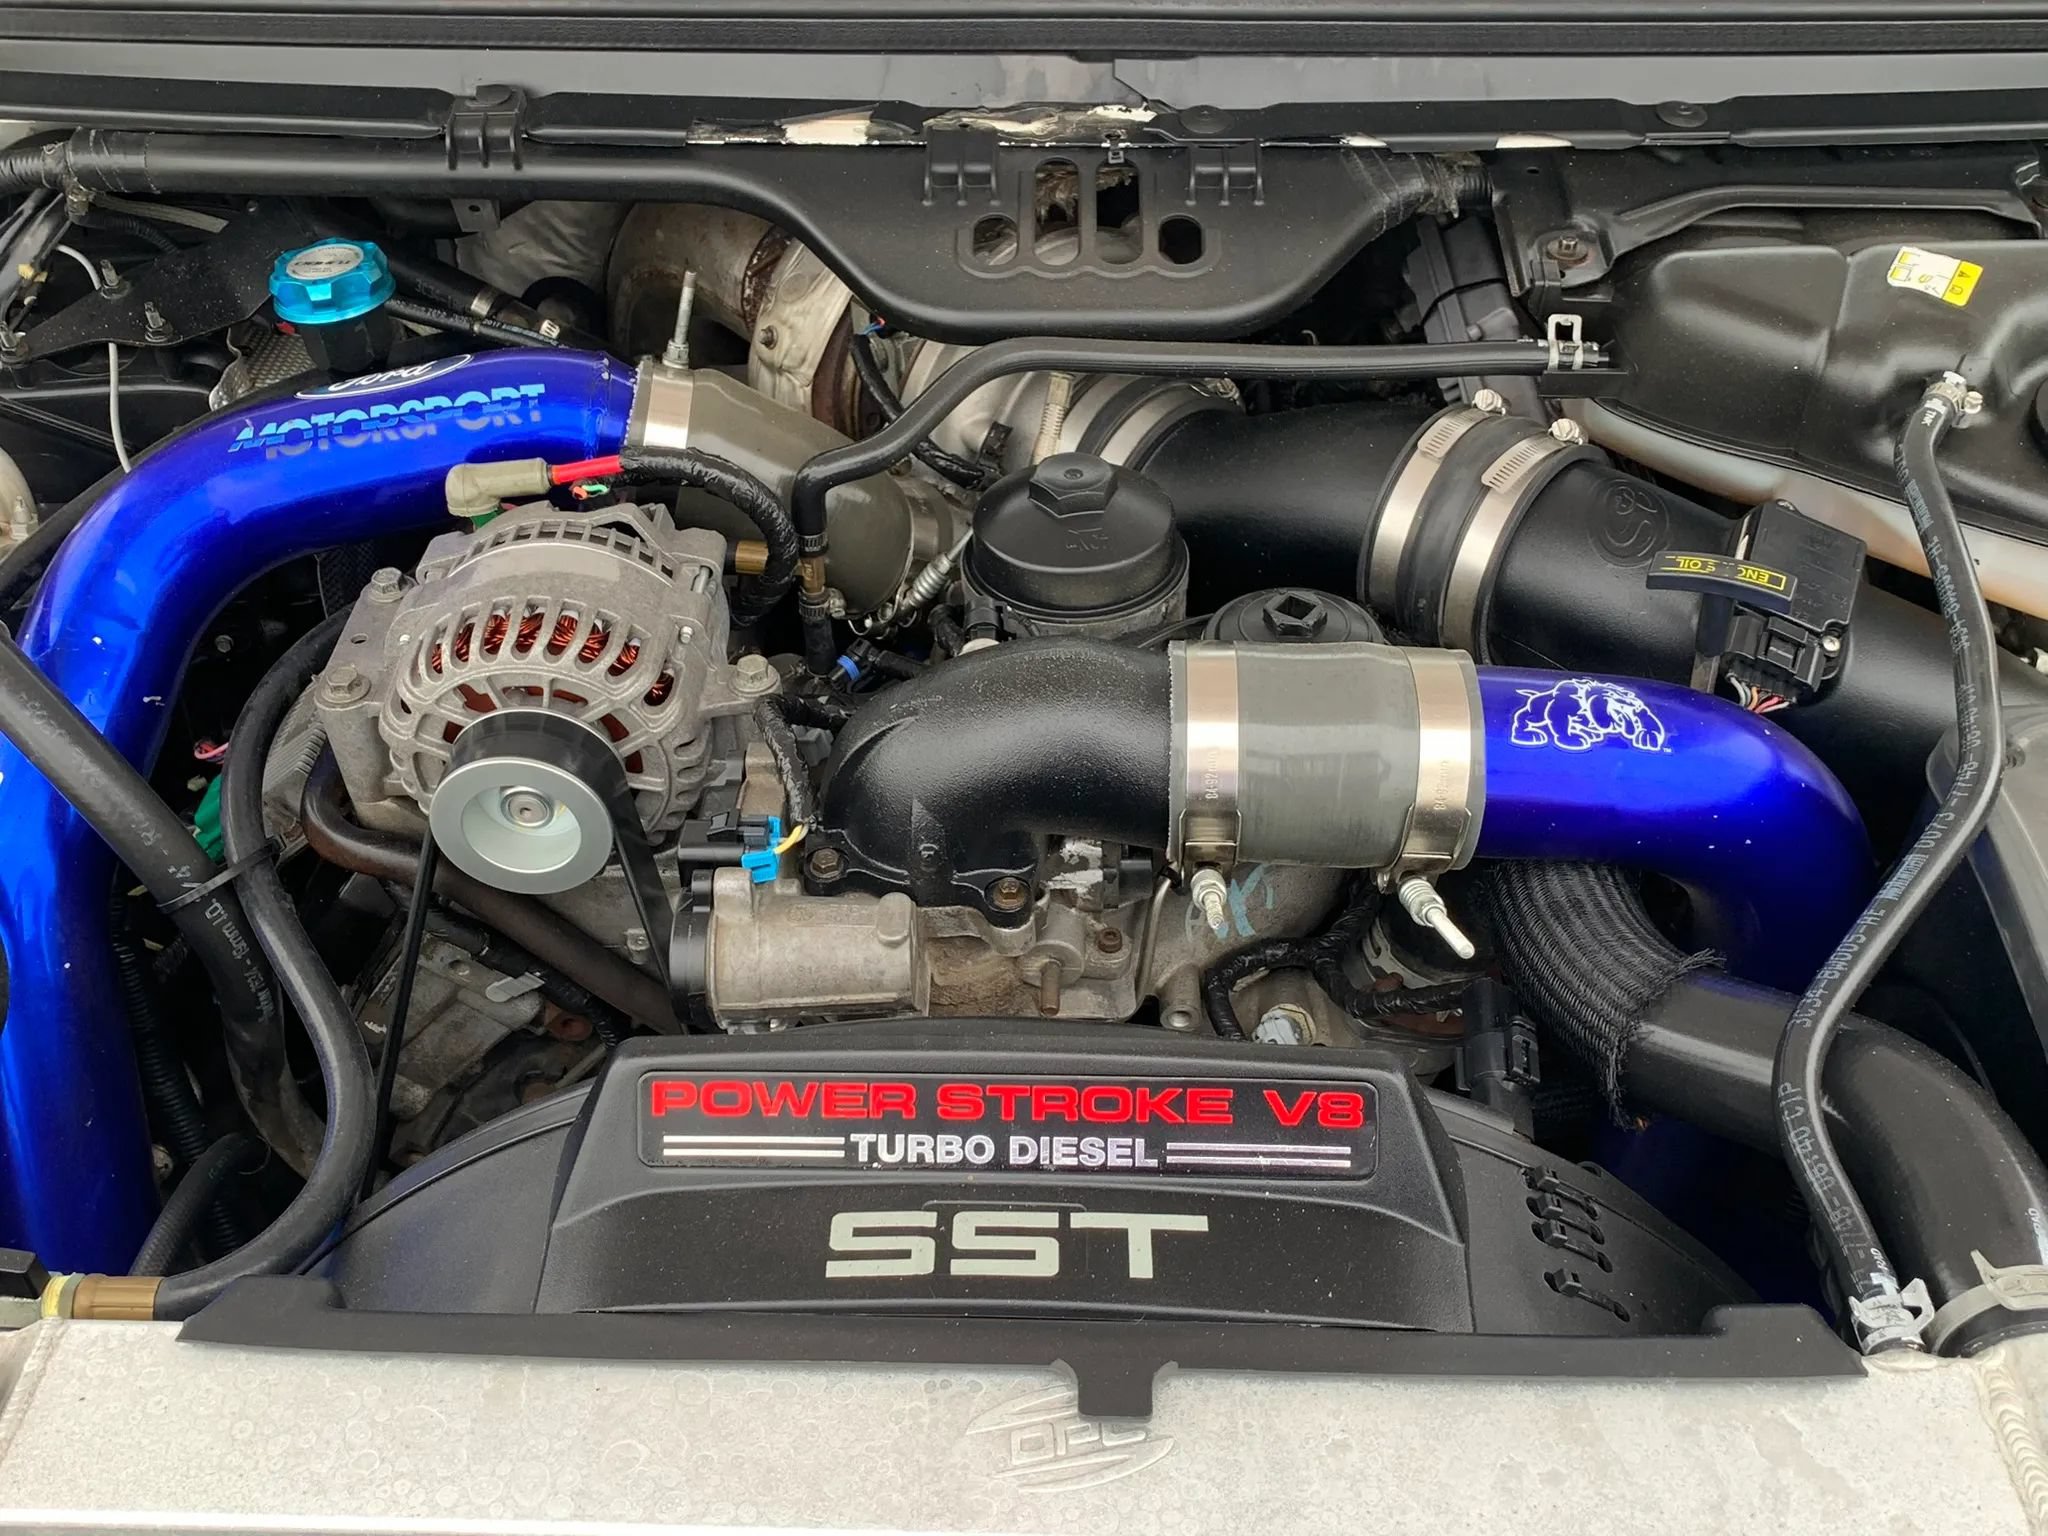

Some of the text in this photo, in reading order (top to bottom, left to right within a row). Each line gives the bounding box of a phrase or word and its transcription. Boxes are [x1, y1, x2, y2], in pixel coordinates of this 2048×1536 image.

[227, 383, 546, 460] MOTORSPORT
[1675, 558, 1702, 570] OIL
[651, 1081, 1366, 1128] POWER STROKE V8
[850, 1133, 1159, 1168] TURBO DIESEL
[824, 1211, 1209, 1279] SST
